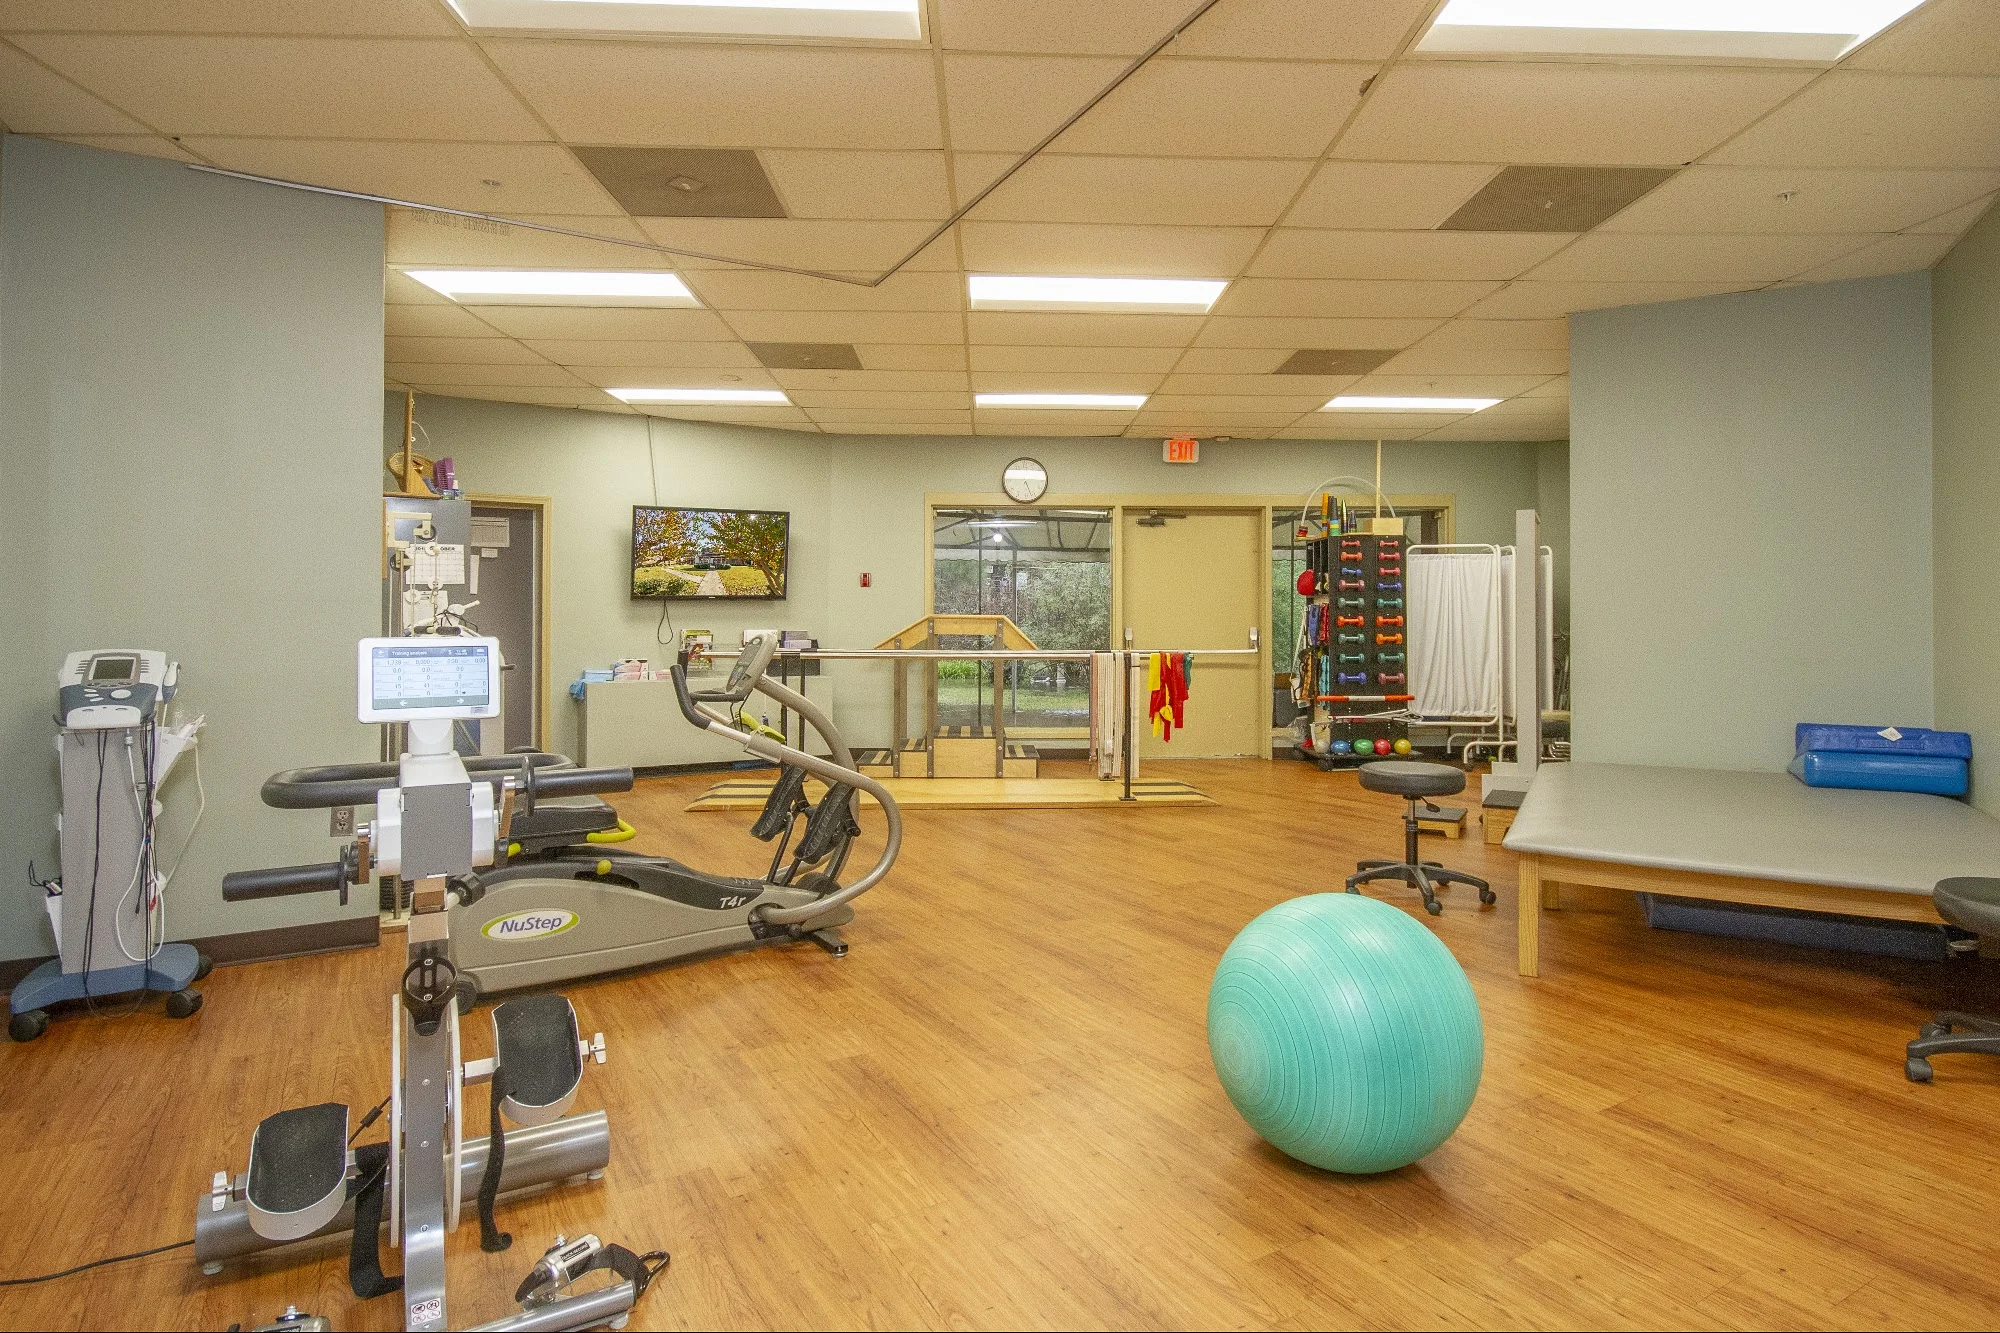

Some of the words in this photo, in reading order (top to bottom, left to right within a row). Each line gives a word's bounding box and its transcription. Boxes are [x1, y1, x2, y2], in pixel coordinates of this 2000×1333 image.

[1169, 440, 1195, 461] EXIT
[720, 896, 746, 909] T4r
[499, 917, 563, 934] NuStep
